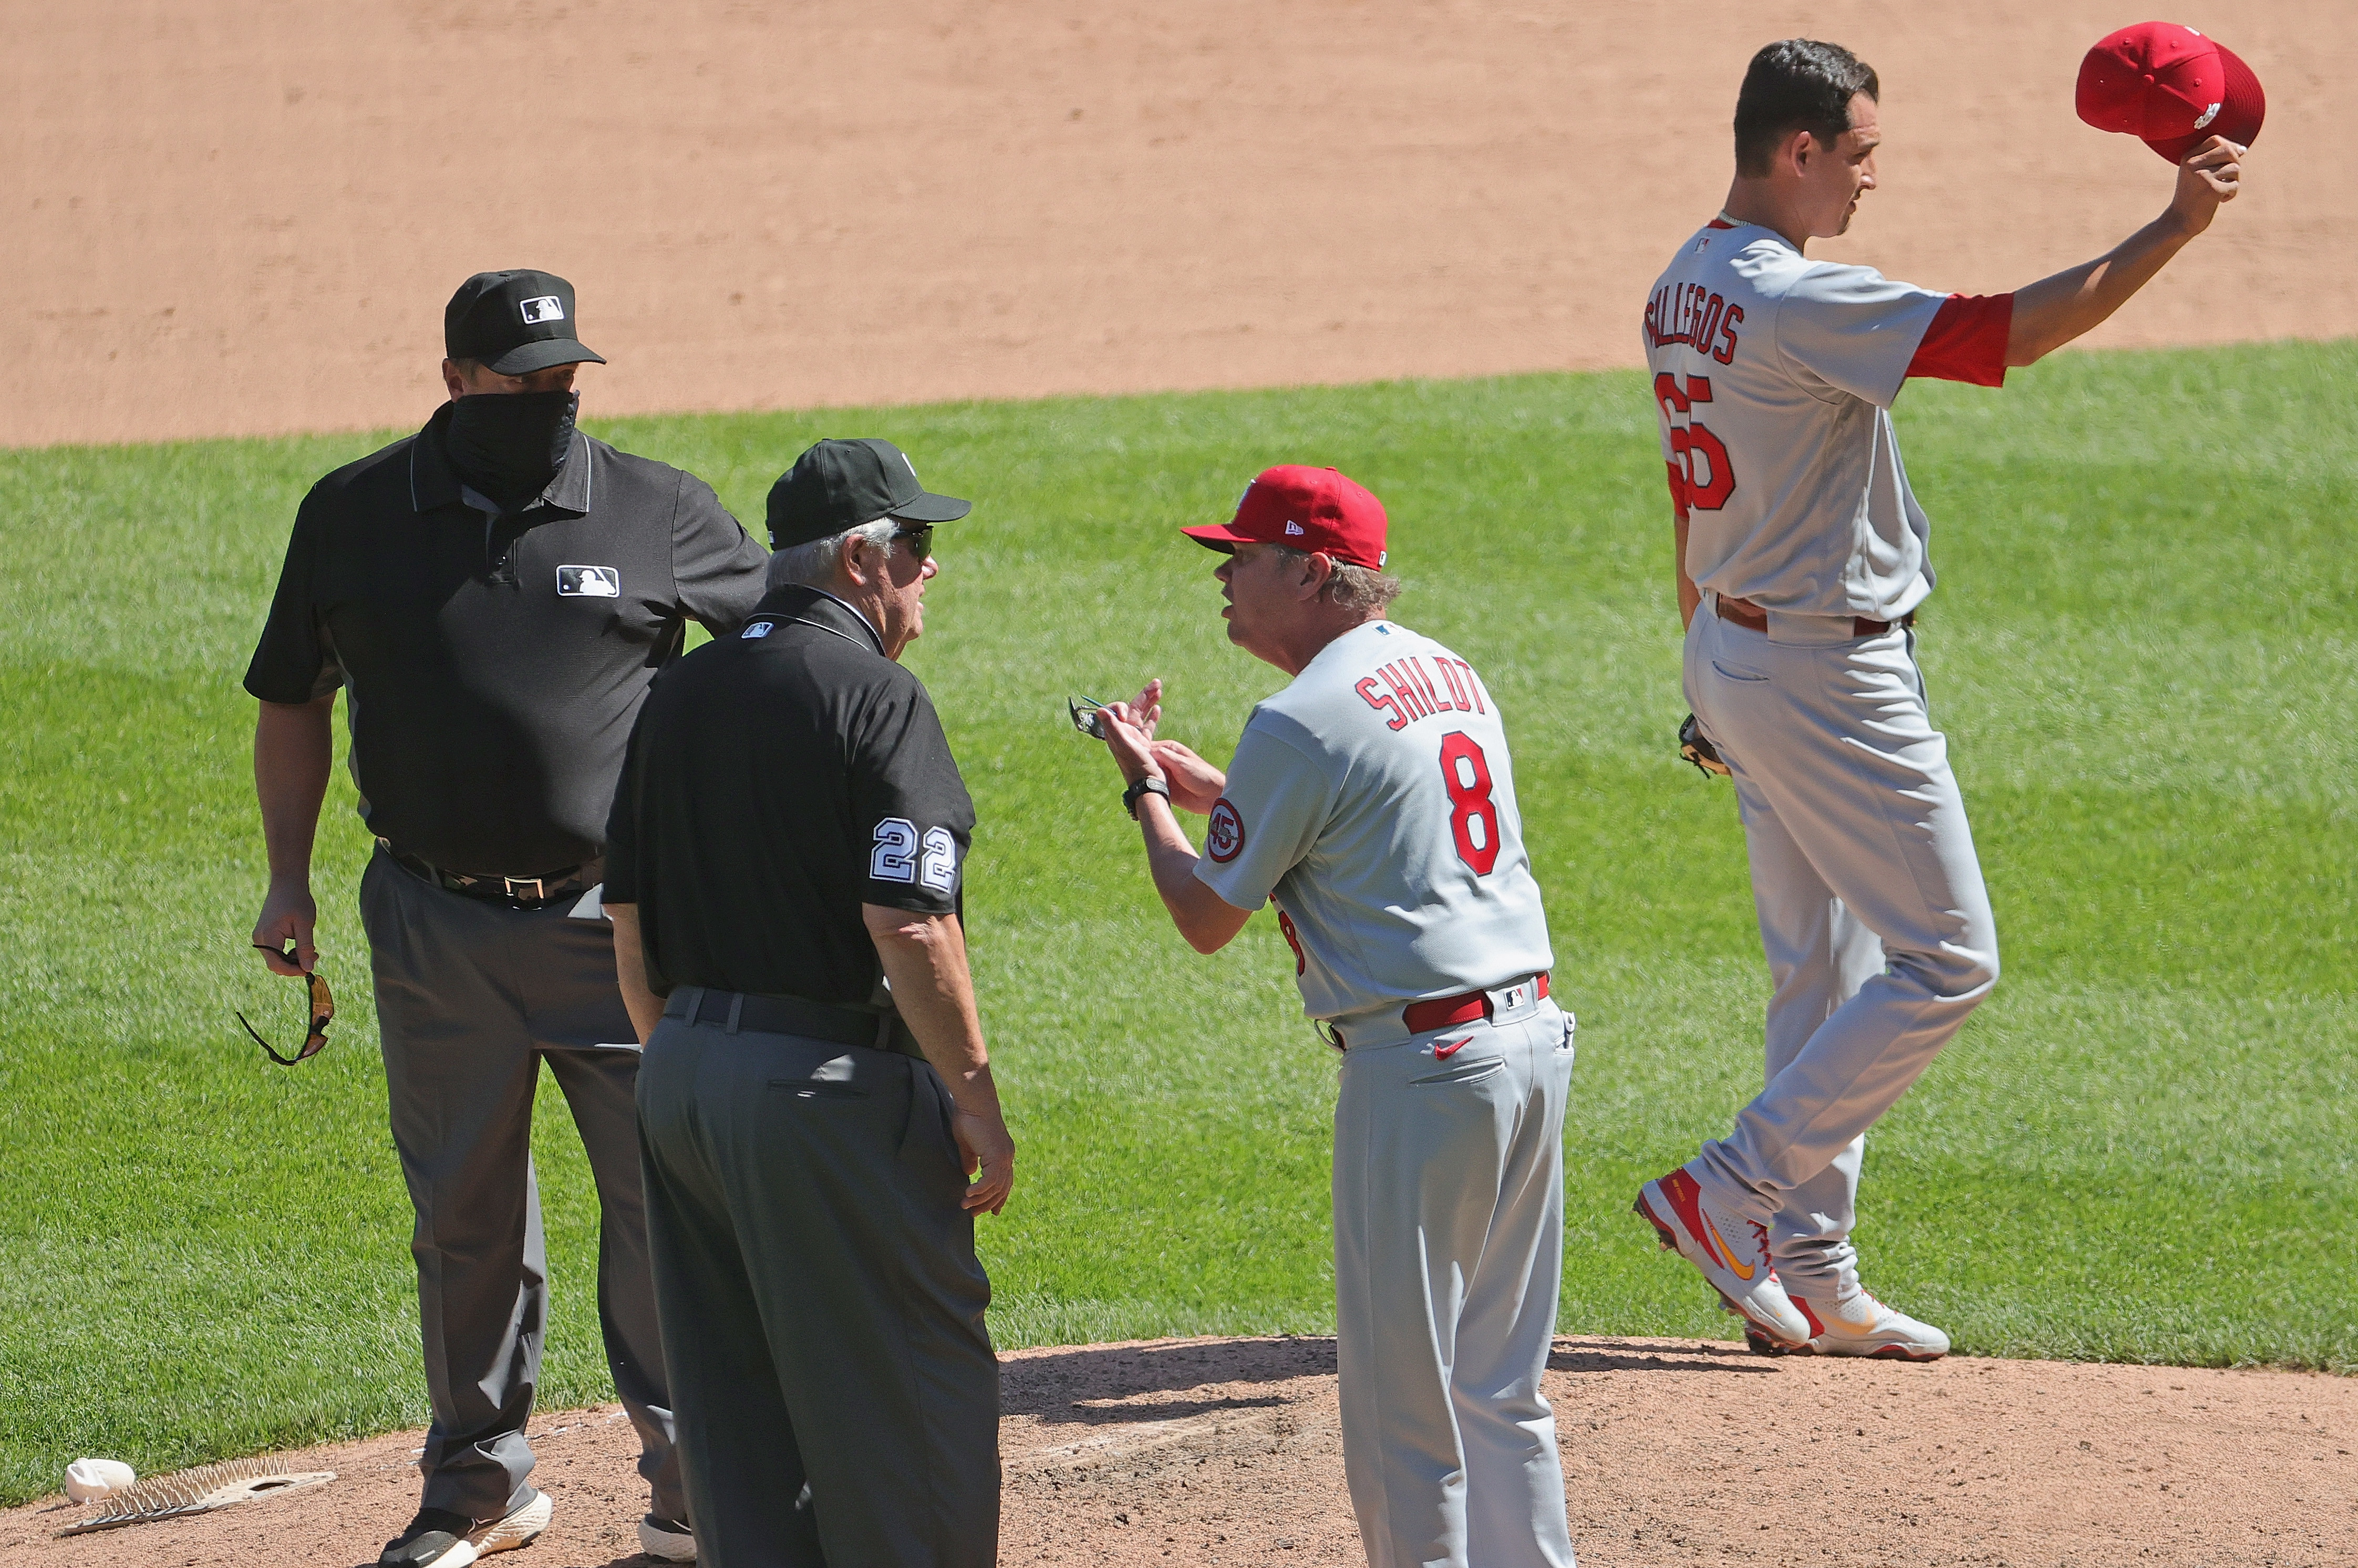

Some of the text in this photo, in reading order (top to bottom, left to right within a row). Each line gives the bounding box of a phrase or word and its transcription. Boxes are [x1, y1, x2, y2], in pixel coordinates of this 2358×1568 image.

[1654, 371, 1736, 510] 65
[1354, 656, 1485, 731] SHILDT
[1210, 813, 1235, 850] 45
[1439, 730, 1501, 877] 8
[869, 817, 956, 894] 22
